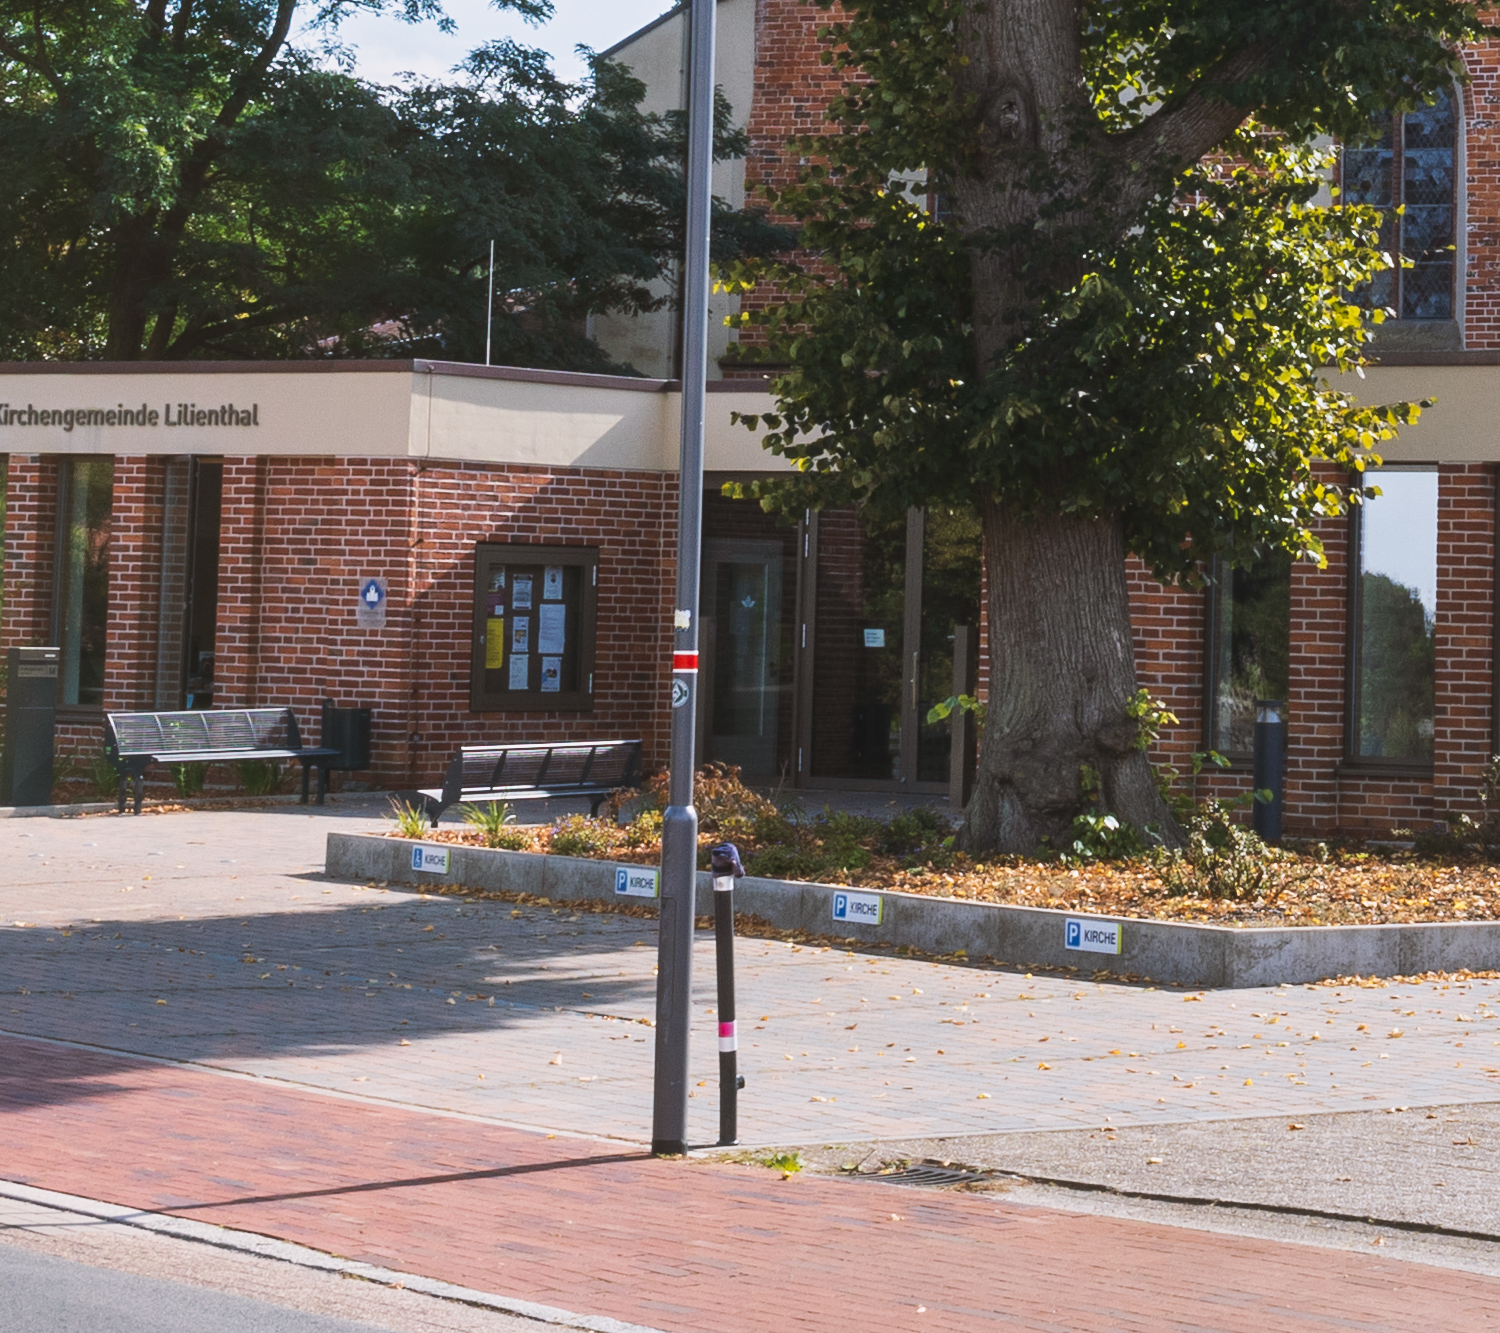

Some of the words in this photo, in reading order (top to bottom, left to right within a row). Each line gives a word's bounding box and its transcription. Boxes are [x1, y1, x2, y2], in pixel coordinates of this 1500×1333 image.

[164, 403, 260, 427] Lilienthal
[425, 854, 446, 867] KIRCHE
[630, 877, 654, 890] KIRCHE
[850, 901, 878, 917] KIRCHE
[1069, 924, 1079, 944] P
[1084, 929, 1116, 945] KIRCHE
